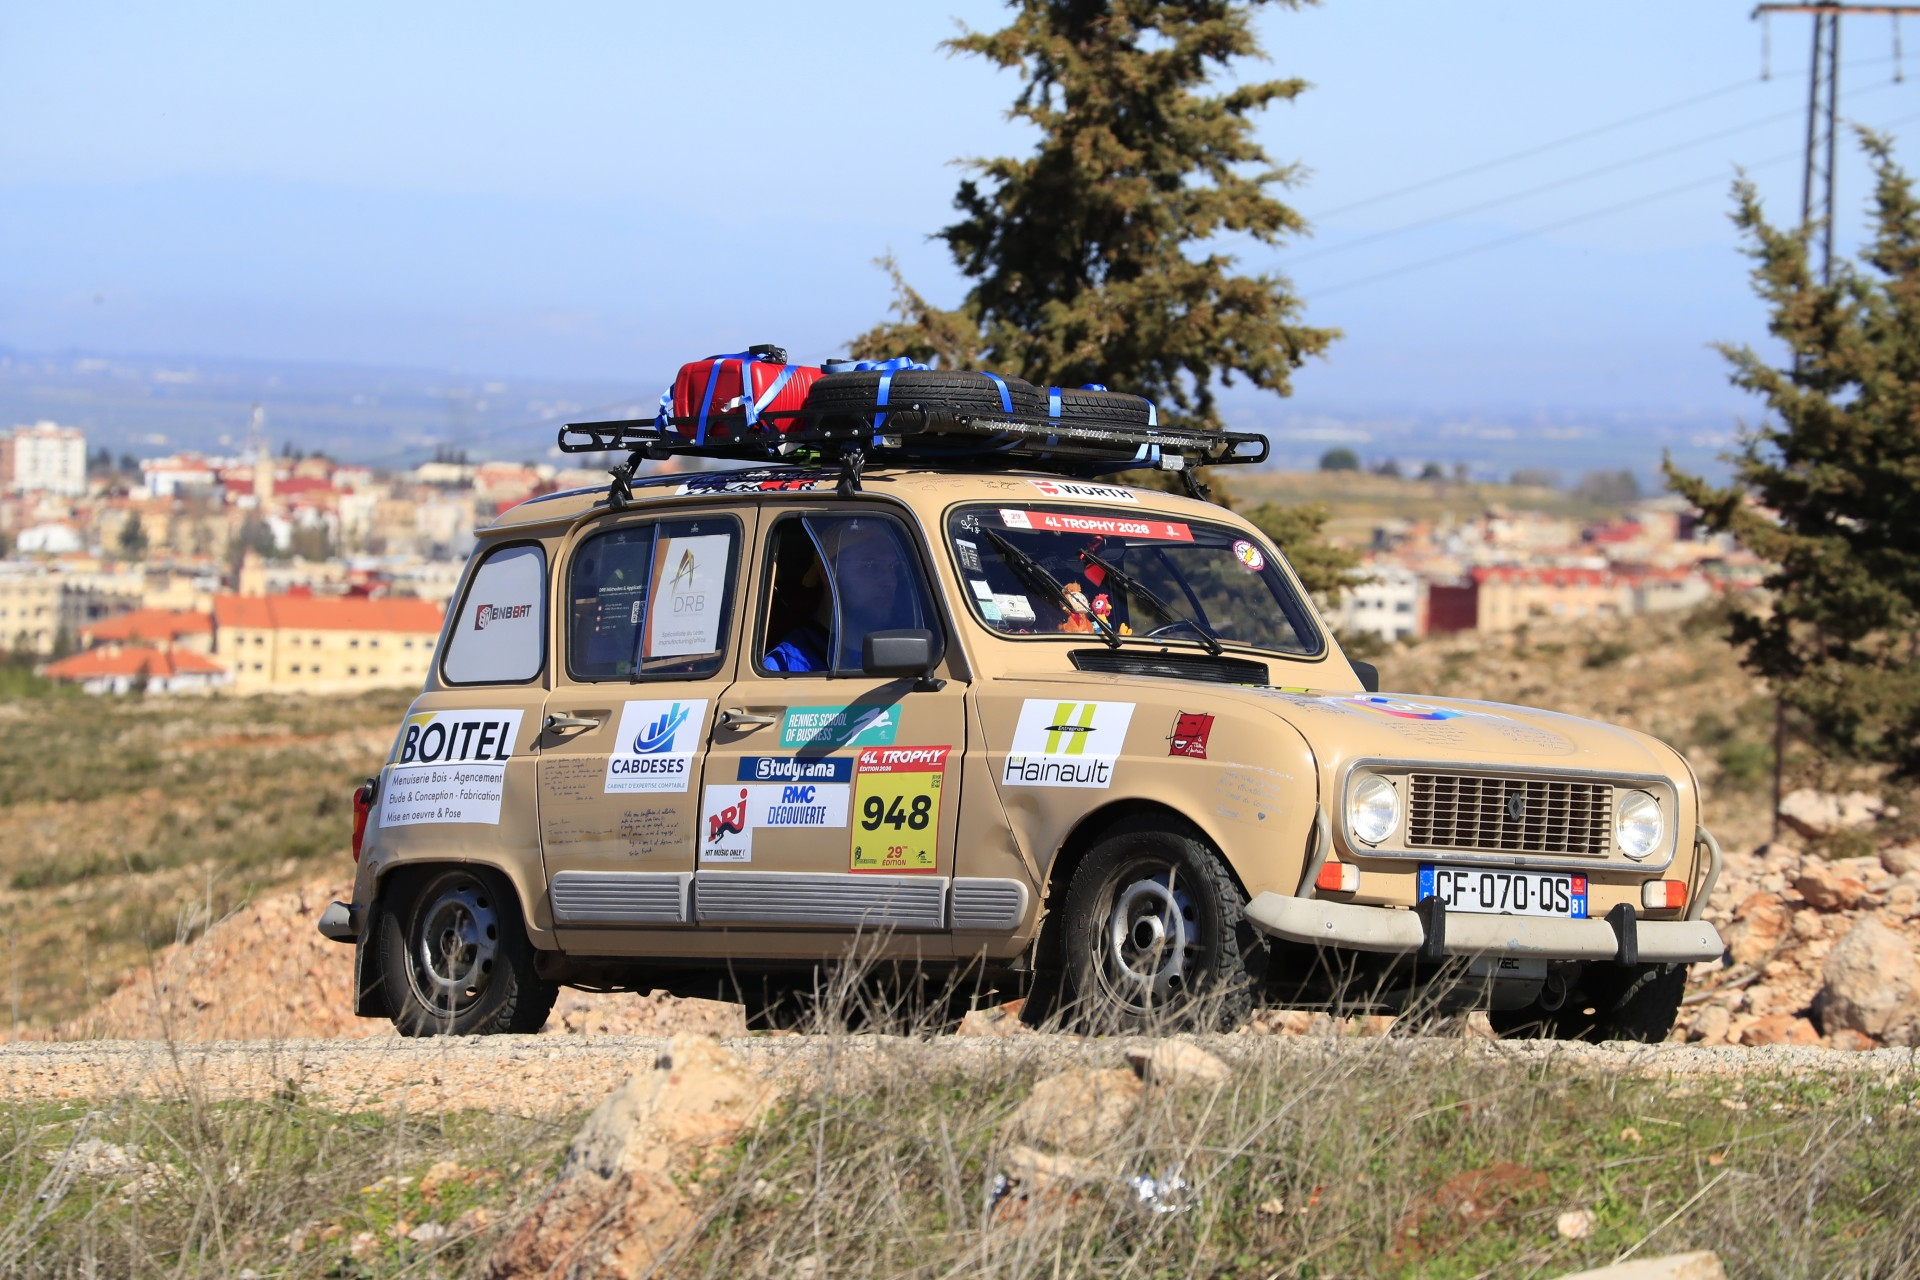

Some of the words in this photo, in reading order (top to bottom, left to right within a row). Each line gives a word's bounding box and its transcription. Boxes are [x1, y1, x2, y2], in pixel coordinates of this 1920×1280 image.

[1058, 483, 1133, 499] WÜRTH
[1045, 516, 1061, 528] 4L
[1061, 517, 1115, 532] TROPHY
[1118, 522, 1150, 534] 2026
[673, 595, 705, 613] DRB
[788, 713, 819, 727] RENNES
[819, 712, 847, 727] SCHOOL
[785, 728, 796, 742] OF
[797, 727, 832, 742] BUSINESS
[399, 722, 511, 764] BOITEL
[860, 750, 878, 764] 4L
[882, 749, 946, 764] TROPHY
[611, 758, 684, 774] CABDESES
[757, 758, 835, 781] Studyrama
[1005, 756, 1109, 783] Hainault
[392, 773, 429, 786] Menuiserie
[432, 771, 447, 783] Bois
[453, 771, 502, 785] Agencement
[407, 791, 413, 802] &
[415, 790, 454, 803] Conception
[460, 789, 500, 801] Fabrication
[782, 785, 816, 803] RMC
[386, 811, 400, 822] Mise
[402, 812, 410, 820] en
[412, 811, 435, 820] oeuvre
[437, 808, 443, 818] &
[444, 808, 461, 818] Pose
[767, 805, 826, 825] DÉCOUVERTE
[861, 794, 932, 831] 948
[704, 849, 713, 857] HIT
[713, 849, 729, 857] MUSIC
[729, 849, 742, 857] ONLY
[1572, 898, 1585, 915] 81
